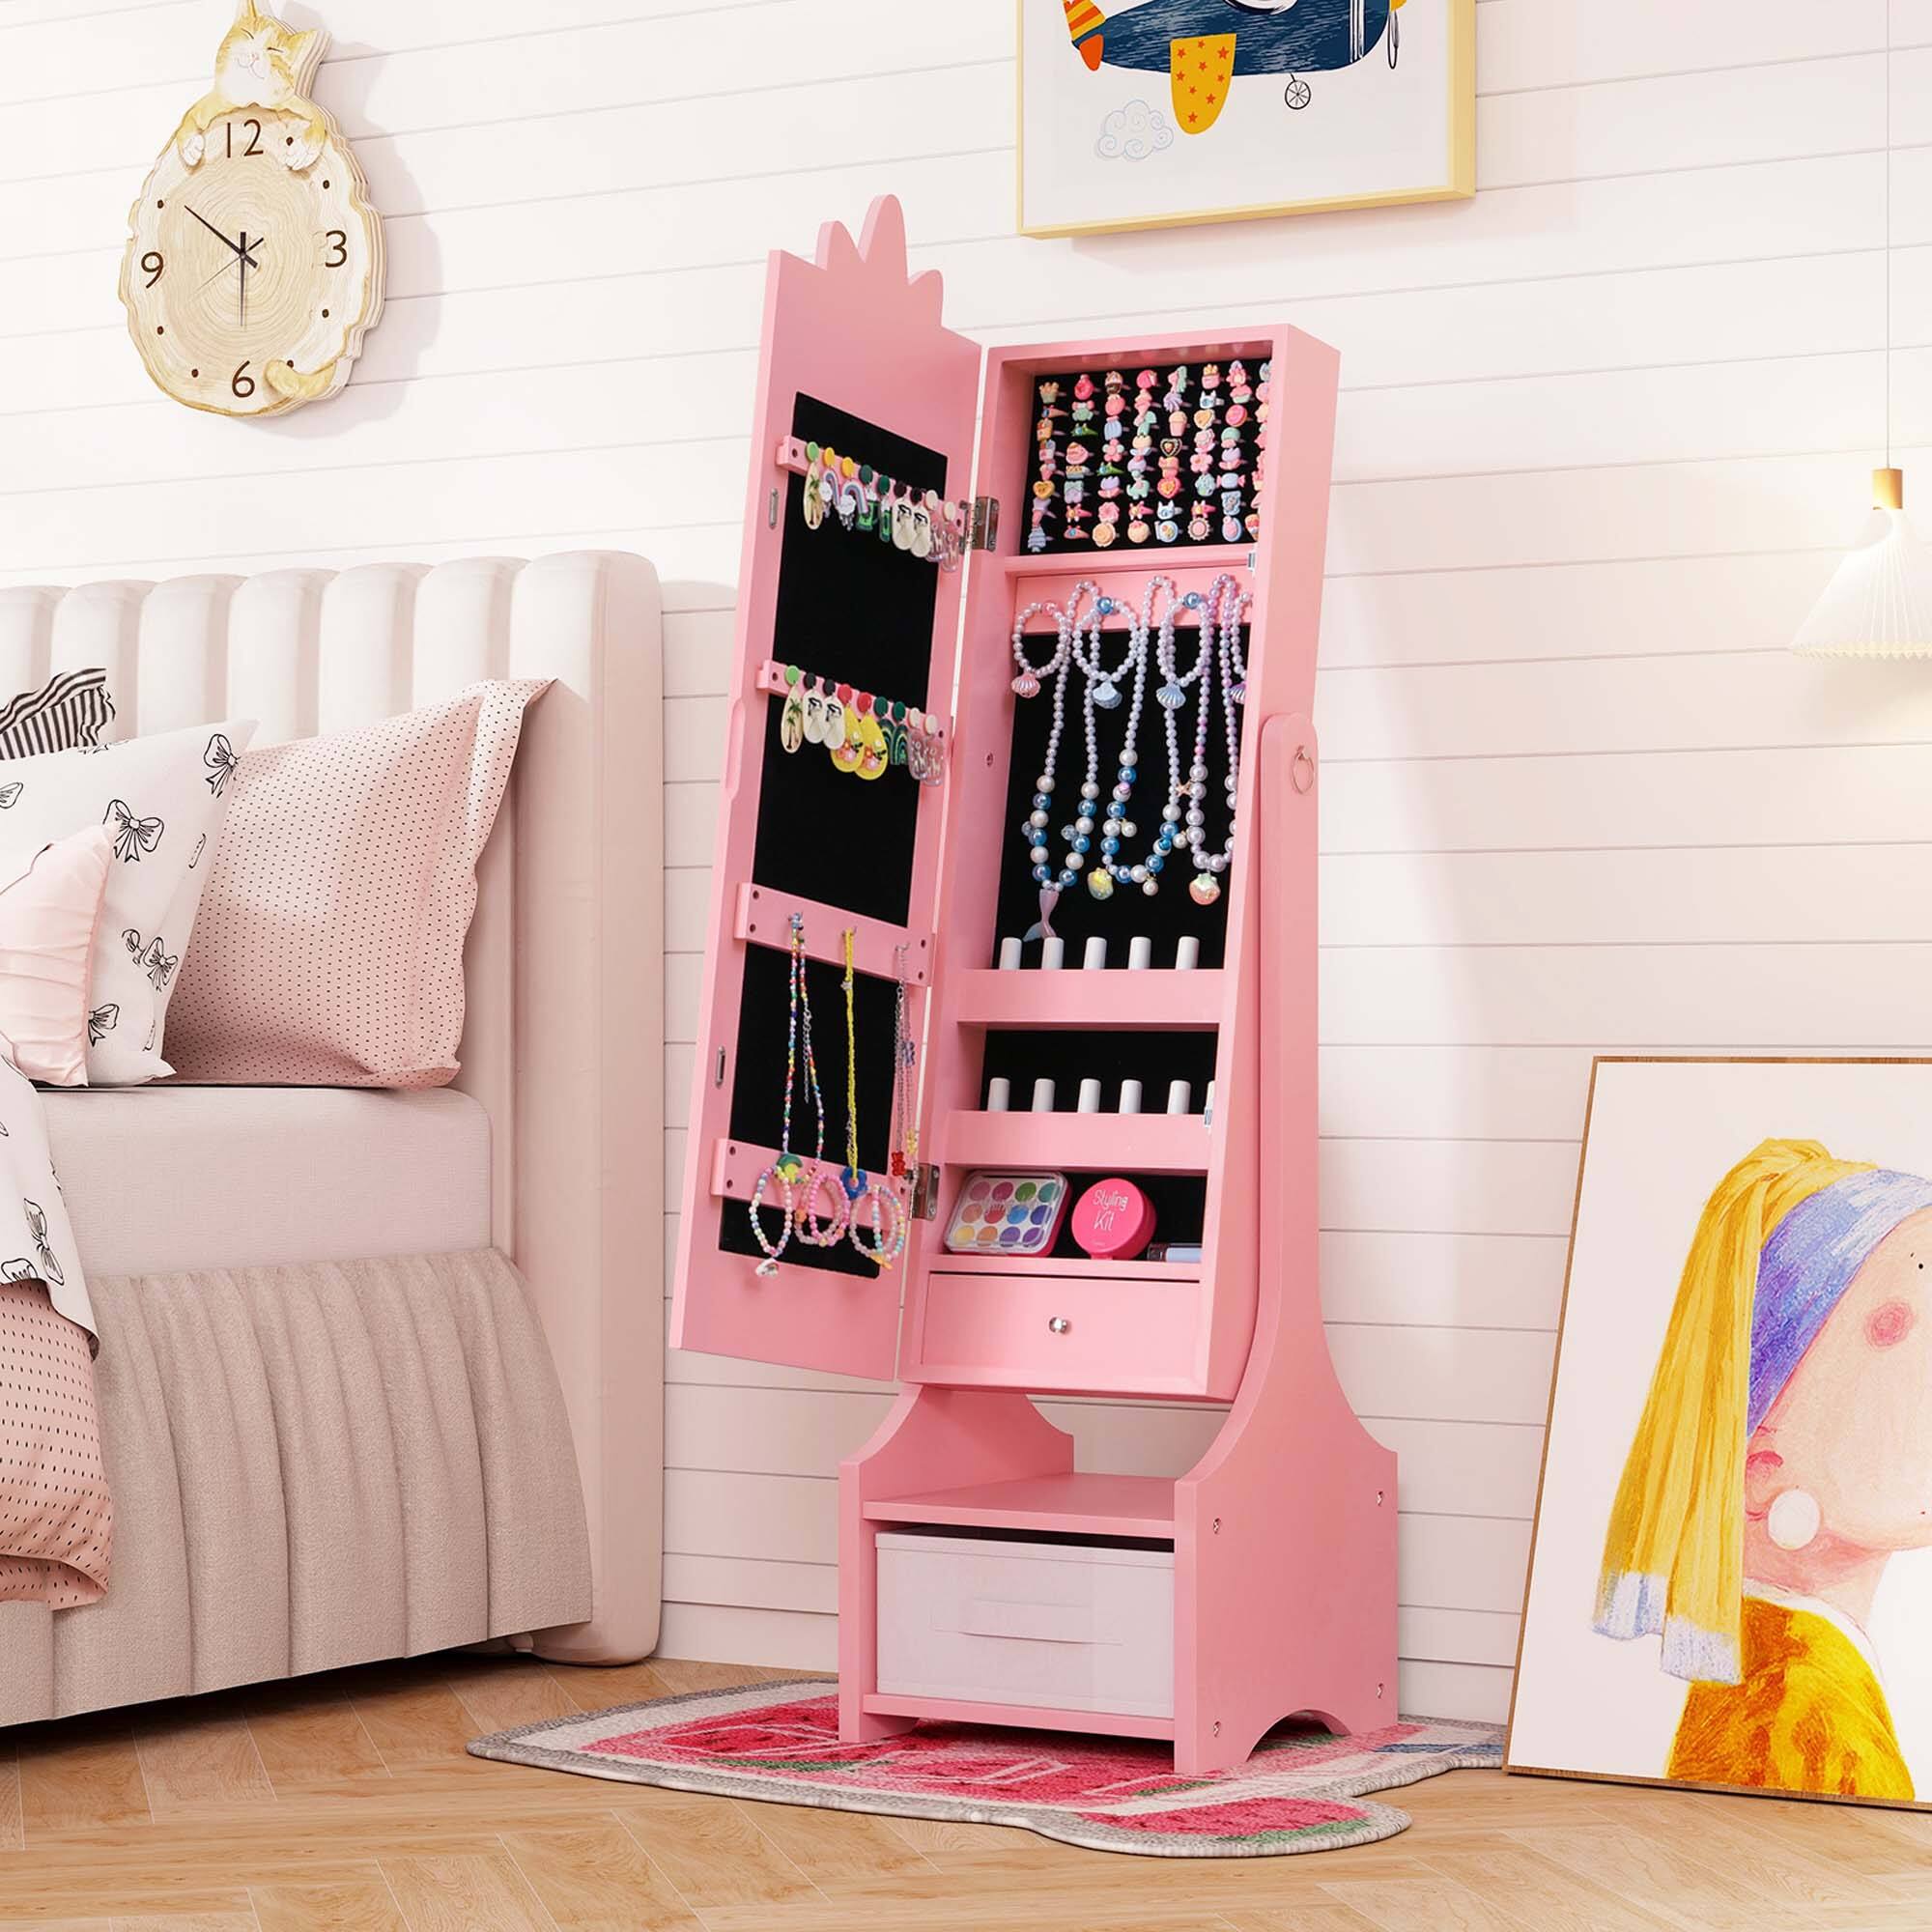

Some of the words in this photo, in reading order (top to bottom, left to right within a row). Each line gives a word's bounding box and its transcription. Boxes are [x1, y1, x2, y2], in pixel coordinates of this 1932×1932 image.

[227, 119, 264, 158] 12
[325, 230, 348, 269] 3
[141, 251, 164, 289] 9
[231, 360, 256, 398] 6
[1093, 1189, 1129, 1212] Styling
[1094, 1210, 1115, 1232] Kit
